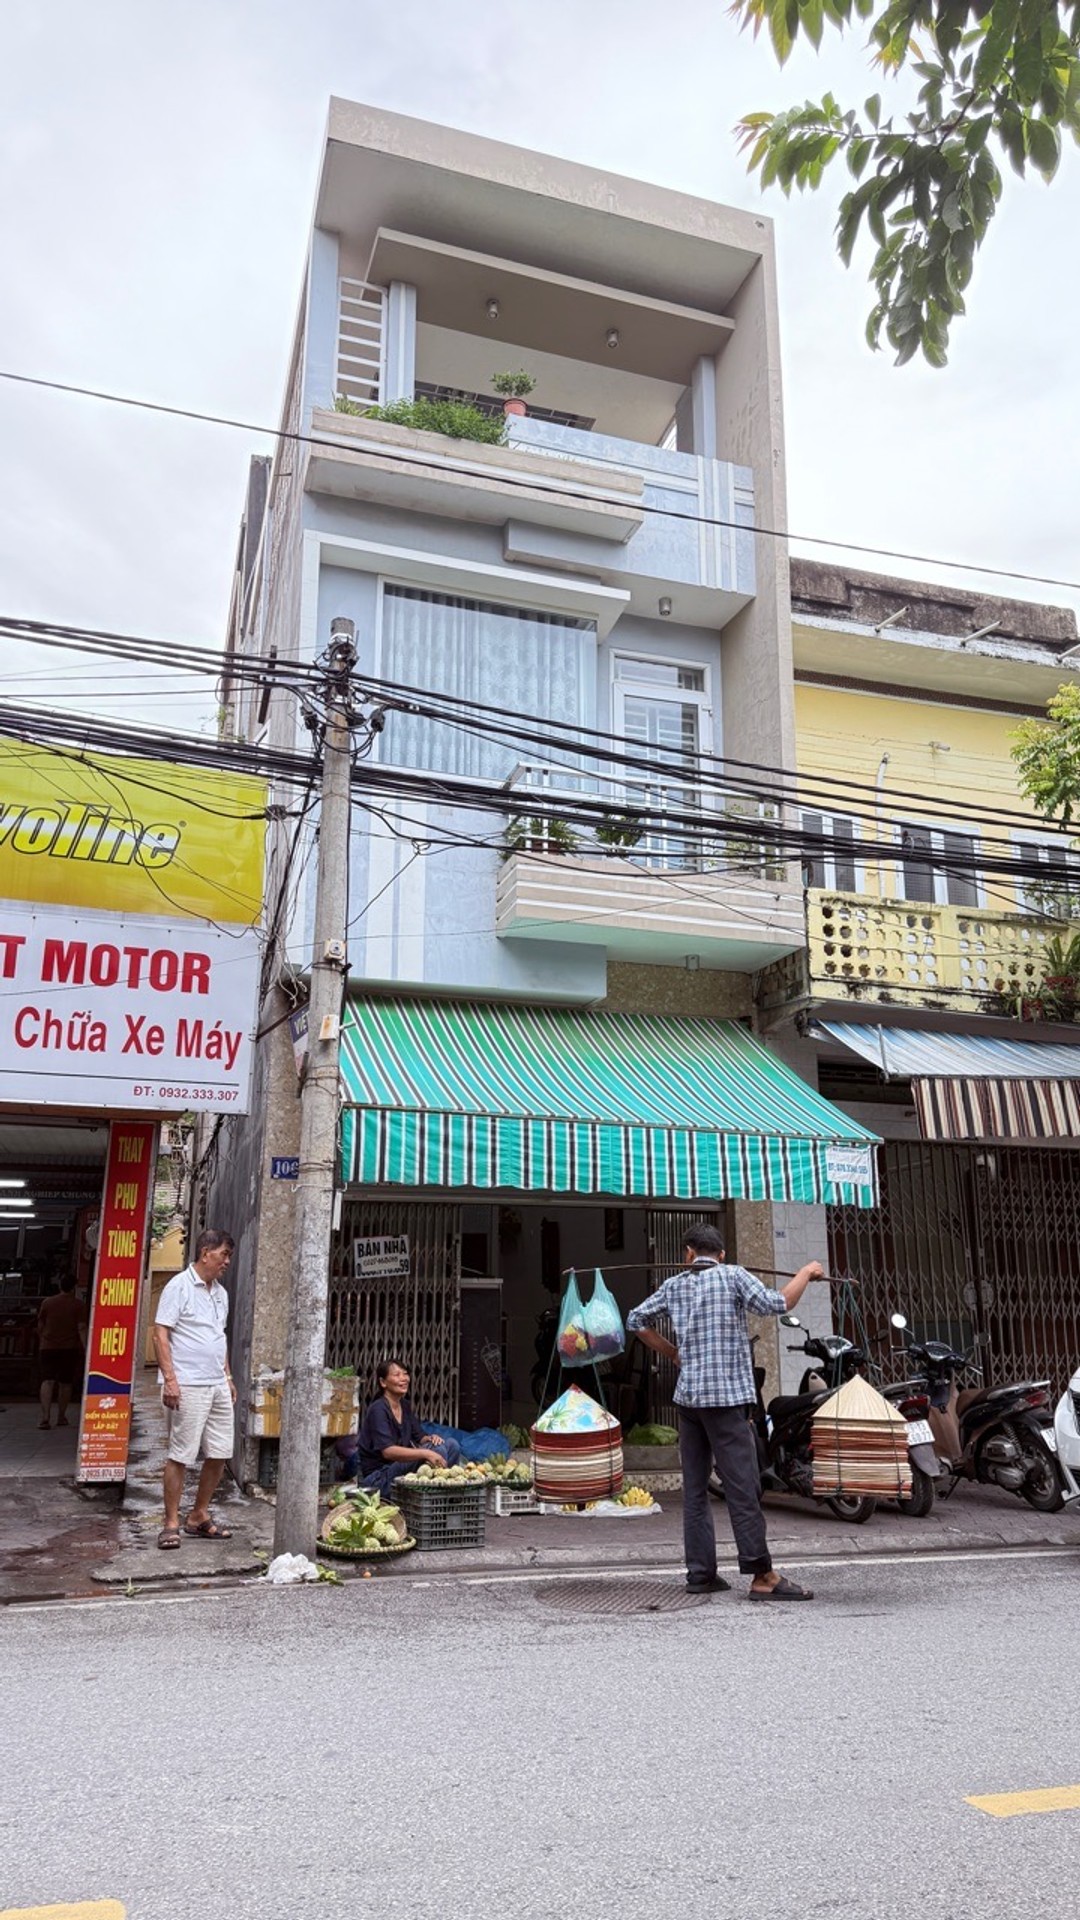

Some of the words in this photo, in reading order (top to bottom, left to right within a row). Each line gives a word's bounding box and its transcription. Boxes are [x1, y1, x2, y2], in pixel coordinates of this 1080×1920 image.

[41, 939, 211, 995] MOTOR
[14, 1006, 107, 1053] Chữa
[121, 1014, 165, 1056] Xe
[175, 1019, 243, 1071] Máy
[133, 1086, 155, 1097] ĐT:
[159, 1087, 239, 1101] 0932.333.307
[118, 1137, 145, 1163] THAY
[114, 1183, 138, 1216] PHỤ
[107, 1224, 138, 1258] TÙNG
[357, 1239, 380, 1259] BÁN
[384, 1236, 408, 1255] NHÀ
[100, 1272, 136, 1307] CHÍNH
[99, 1321, 128, 1362] HIỆU
